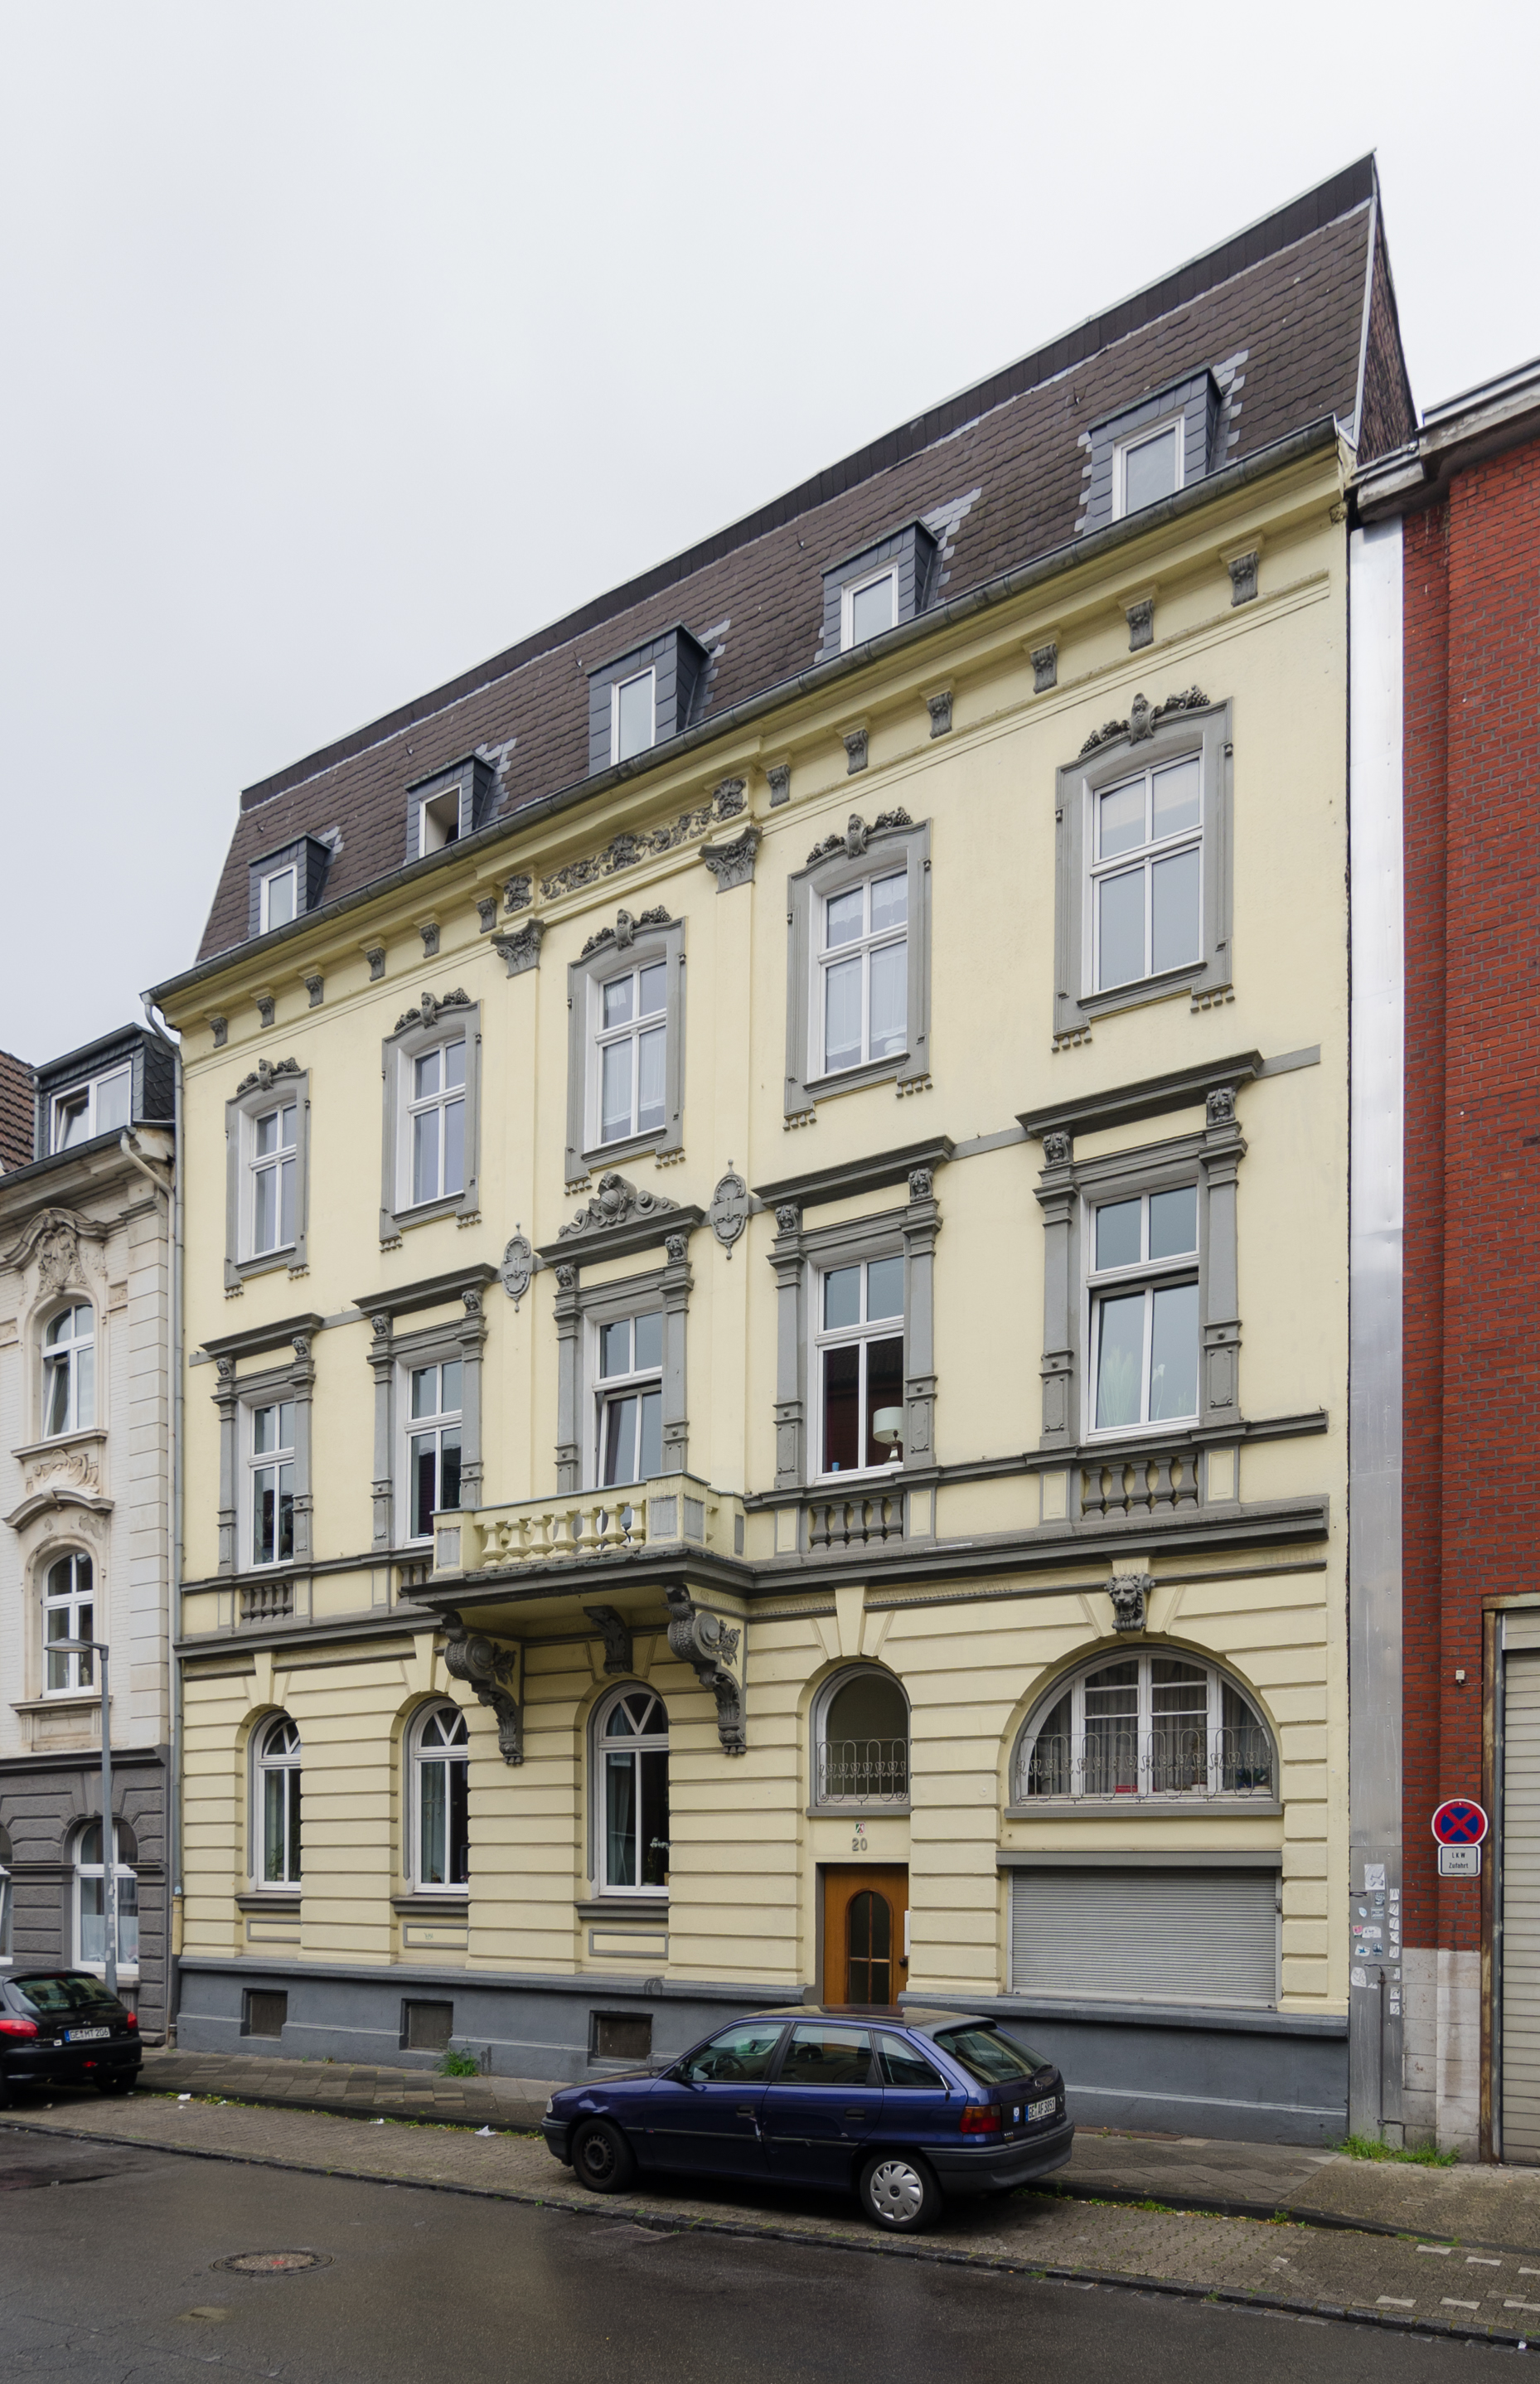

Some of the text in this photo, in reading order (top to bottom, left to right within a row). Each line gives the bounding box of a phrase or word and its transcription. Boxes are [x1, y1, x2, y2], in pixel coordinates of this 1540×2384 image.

[852, 1837, 868, 1852] 20
[70, 2028, 109, 2039] GE MT 206
